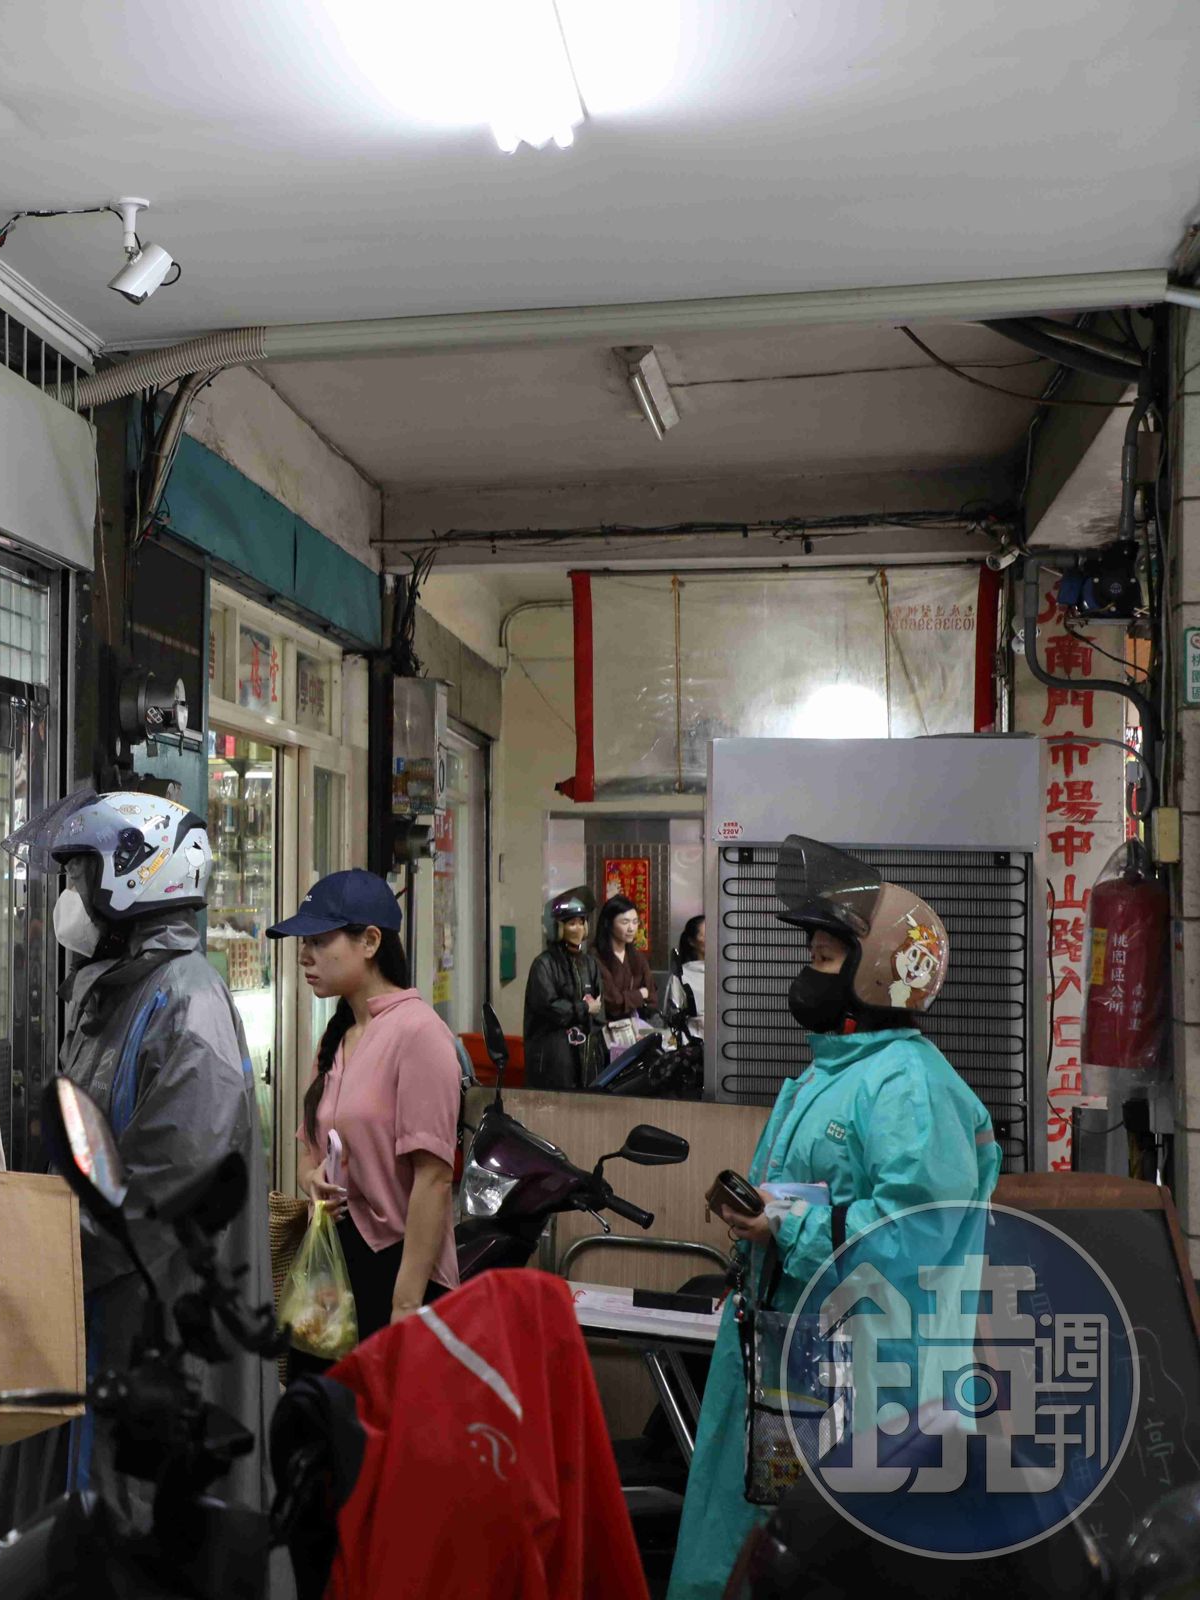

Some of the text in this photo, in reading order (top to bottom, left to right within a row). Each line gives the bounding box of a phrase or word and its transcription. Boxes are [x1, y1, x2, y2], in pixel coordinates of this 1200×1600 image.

[1037, 580, 1102, 1172] 南門市場中山路入口立
